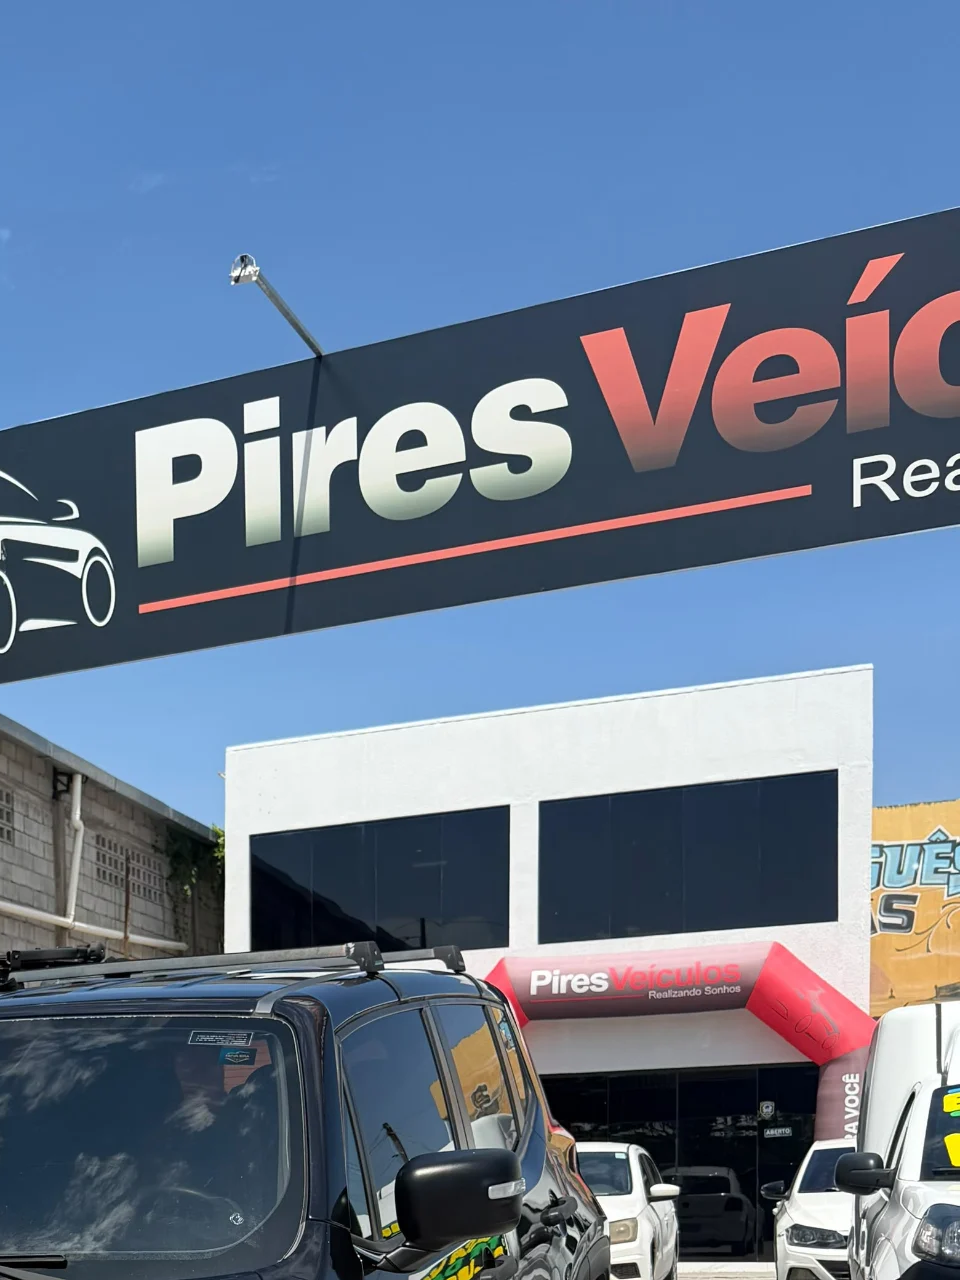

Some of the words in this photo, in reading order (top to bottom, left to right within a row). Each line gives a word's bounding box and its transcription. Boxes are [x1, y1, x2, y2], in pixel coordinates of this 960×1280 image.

[648, 987, 702, 1000] Realizando
[704, 985, 742, 996] Sonhos
[765, 1127, 791, 1136] ABERTO
